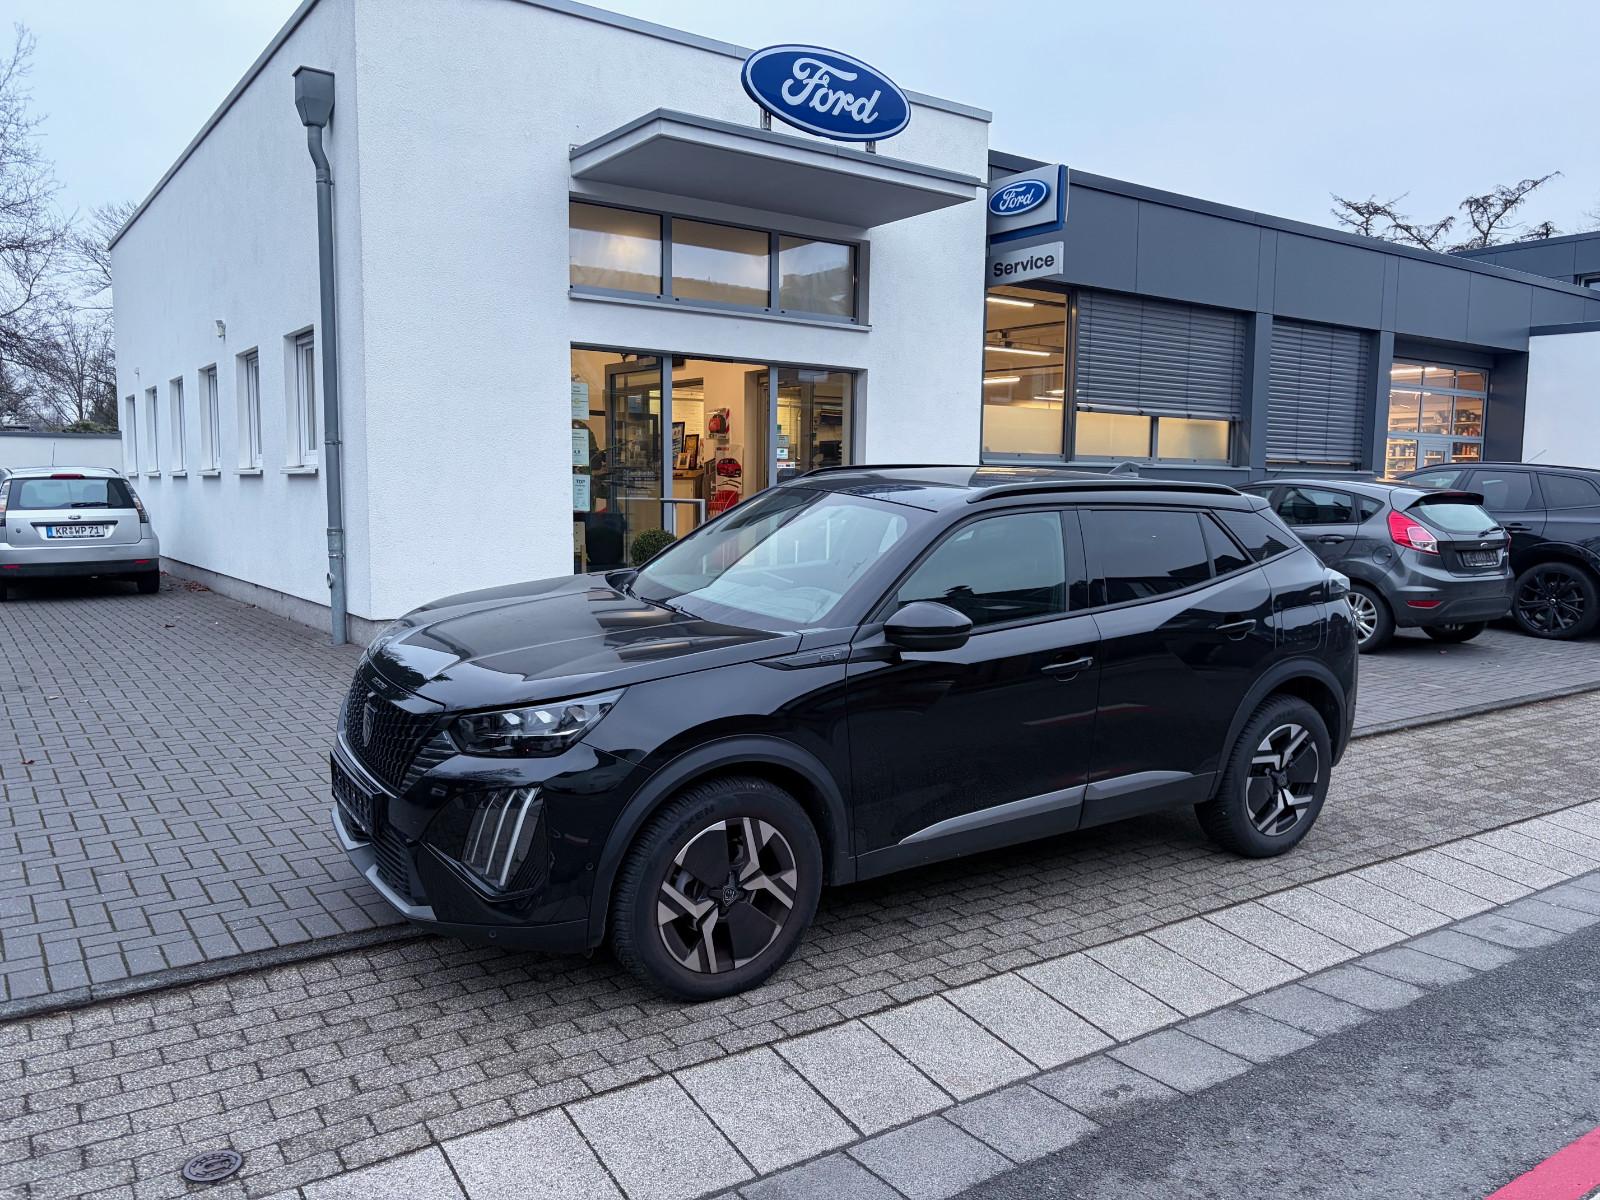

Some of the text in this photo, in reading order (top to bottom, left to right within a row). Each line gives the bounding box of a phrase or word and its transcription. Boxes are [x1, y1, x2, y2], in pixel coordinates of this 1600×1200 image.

[781, 57, 882, 124] Ford
[999, 186, 1035, 211] Ford
[993, 253, 1055, 277] Service
[56, 527, 100, 535] KR WP 71
